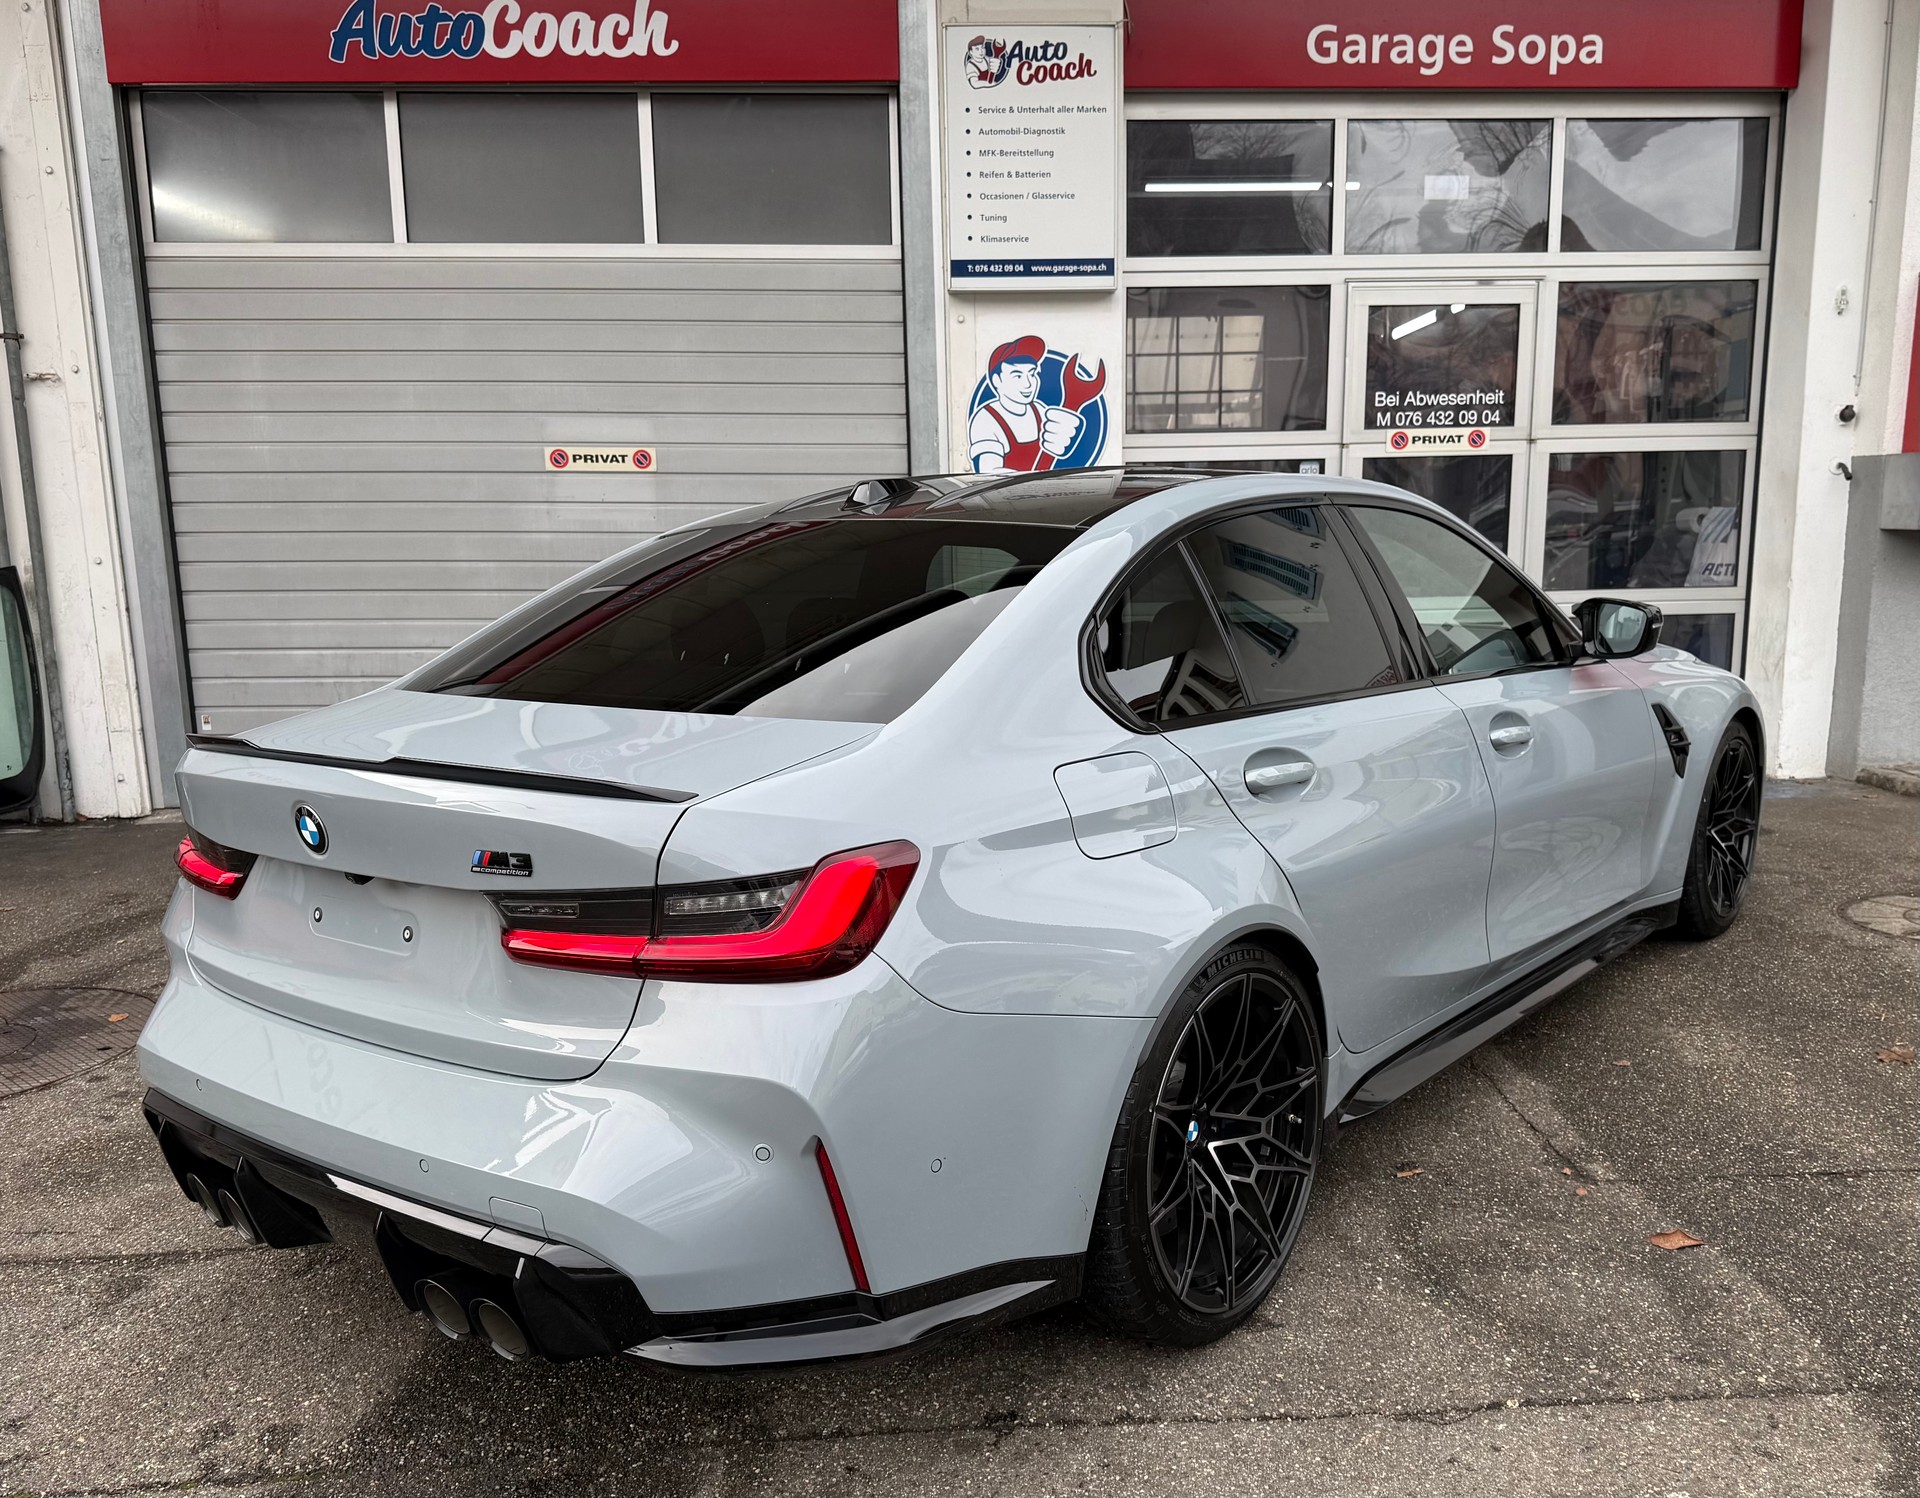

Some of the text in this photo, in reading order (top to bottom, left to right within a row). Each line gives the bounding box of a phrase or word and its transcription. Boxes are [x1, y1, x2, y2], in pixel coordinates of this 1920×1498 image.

[329, 0, 679, 63] AutoCoach
[1006, 40, 1068, 68] Auto
[1306, 24, 1604, 76] Garage Sopa
[1016, 53, 1097, 86] Coach
[978, 105, 1107, 114] Service & Unterhalt aller Marken
[978, 127, 1066, 137] Automobil-Diagnostik
[978, 149, 1054, 158] MFK-Bereitstellung
[980, 192, 1076, 200] Occasionen / Glasservice
[980, 214, 1008, 223] Tuning
[980, 235, 1030, 243] Klimaservice
[975, 264, 989, 273] 076
[989, 264, 1003, 272] 432
[1004, 264, 1014, 272] 09
[1014, 264, 1024, 272] 04
[1031, 263, 1107, 273] www.garage-sopa.ch
[1374, 389, 1505, 407] Bei Abwesenheit
[1376, 410, 1501, 427] M 076 432 09 04
[1411, 434, 1465, 445] PRIVAT
[572, 454, 628, 464] PRIVAT
[480, 867, 529, 876] competition
[1206, 949, 1264, 978] MICHELIN
